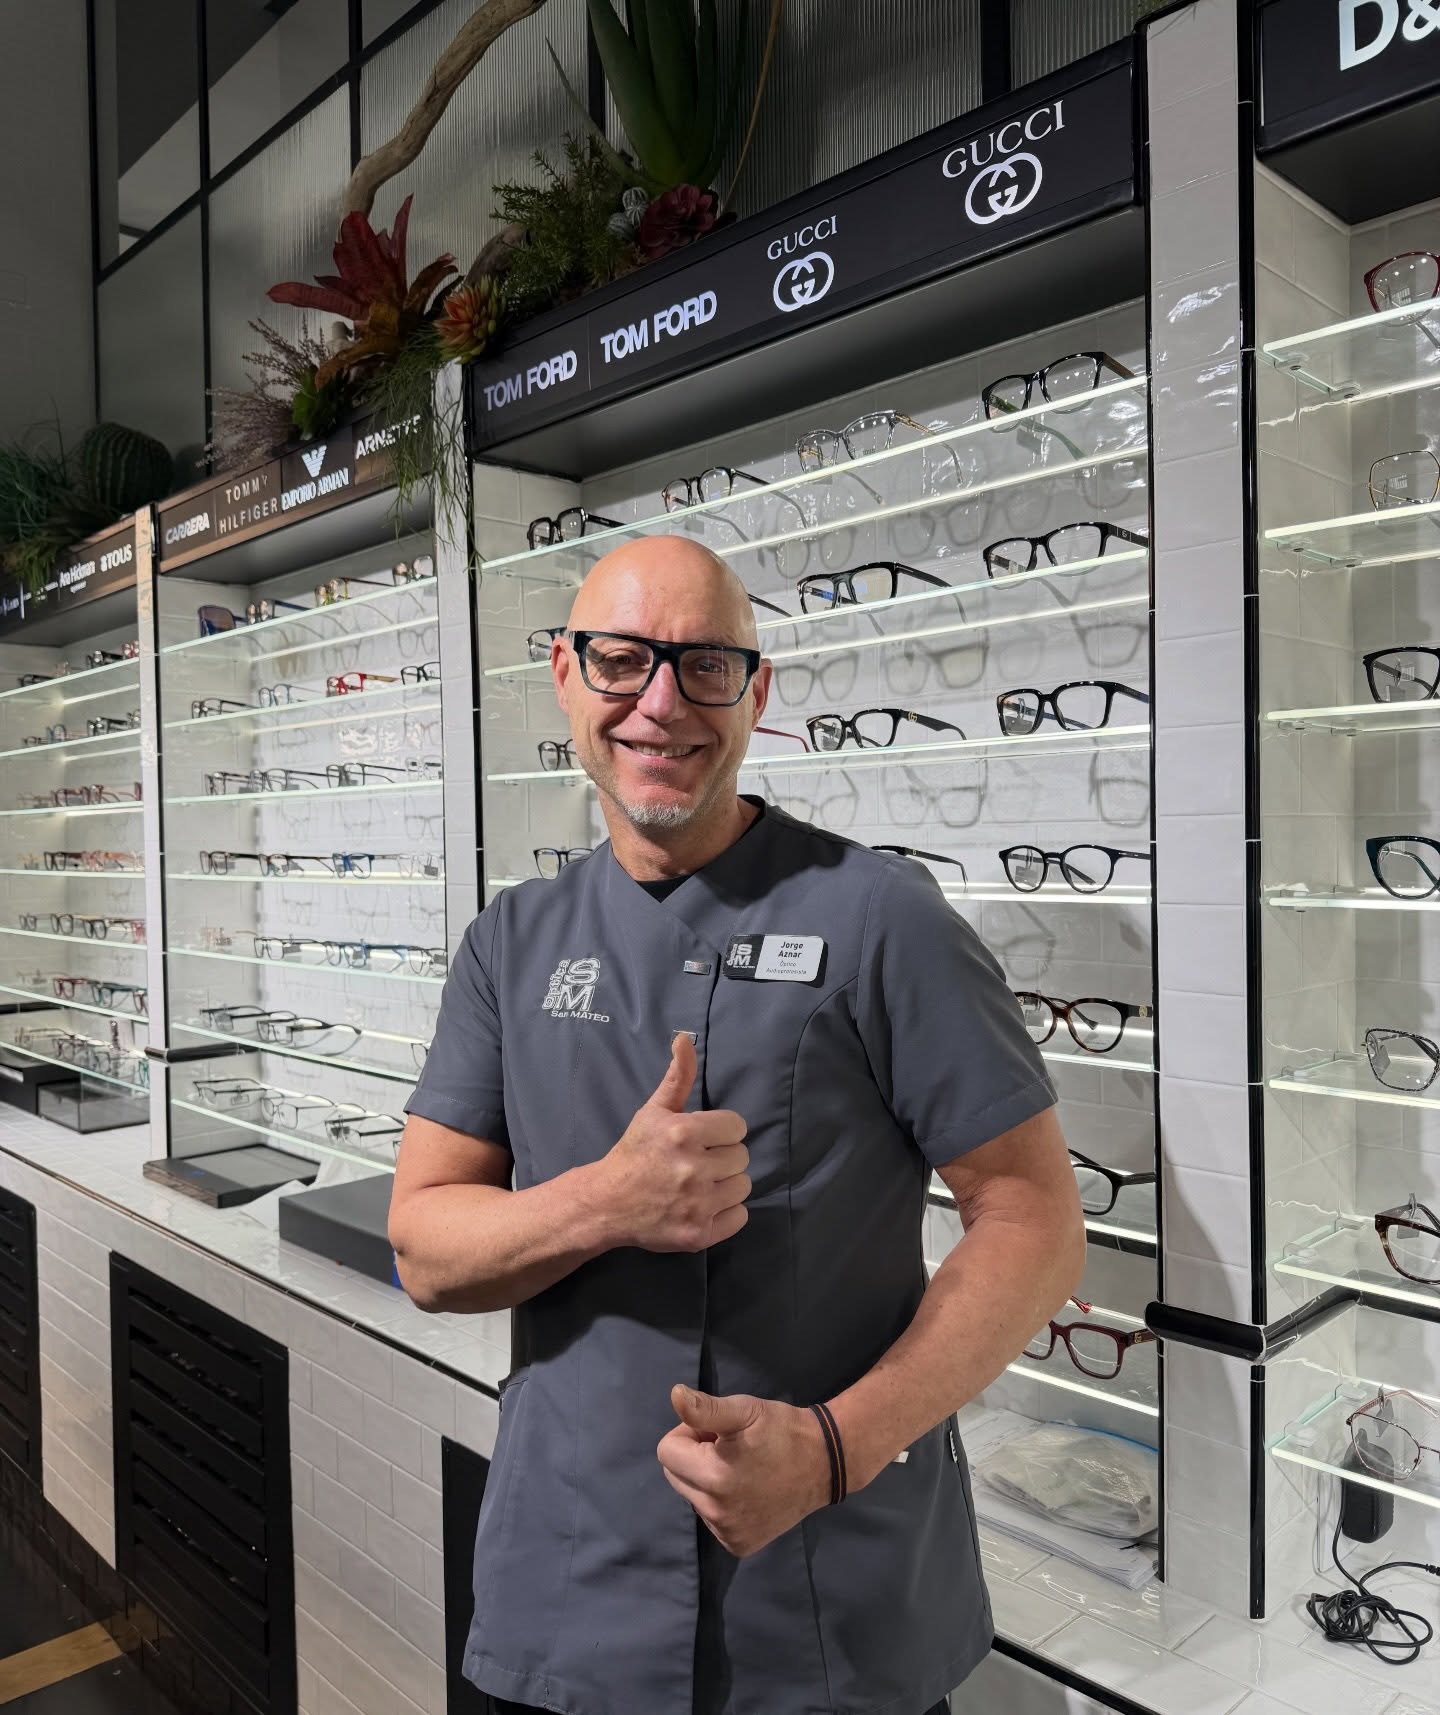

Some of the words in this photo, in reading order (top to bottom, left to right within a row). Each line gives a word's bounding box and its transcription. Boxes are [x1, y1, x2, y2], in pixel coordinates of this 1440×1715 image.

[942, 99, 1065, 179] GUCCI
[767, 214, 838, 260] GUCCI
[599, 318, 649, 364] TOM
[653, 290, 718, 344] FORD
[483, 373, 523, 411] TOM
[526, 349, 578, 396] FORD
[225, 474, 269, 505] TOMMY
[281, 481, 317, 511] EMPORIO
[317, 467, 350, 497] ARMANI
[165, 512, 211, 545] CARRERA
[218, 497, 278, 535] HILFIGER
[107, 544, 133, 570] TOUS
[778, 950, 802, 959] Aznar
[780, 941, 804, 951] Jorge
[570, 1010, 610, 1023] MATEO
